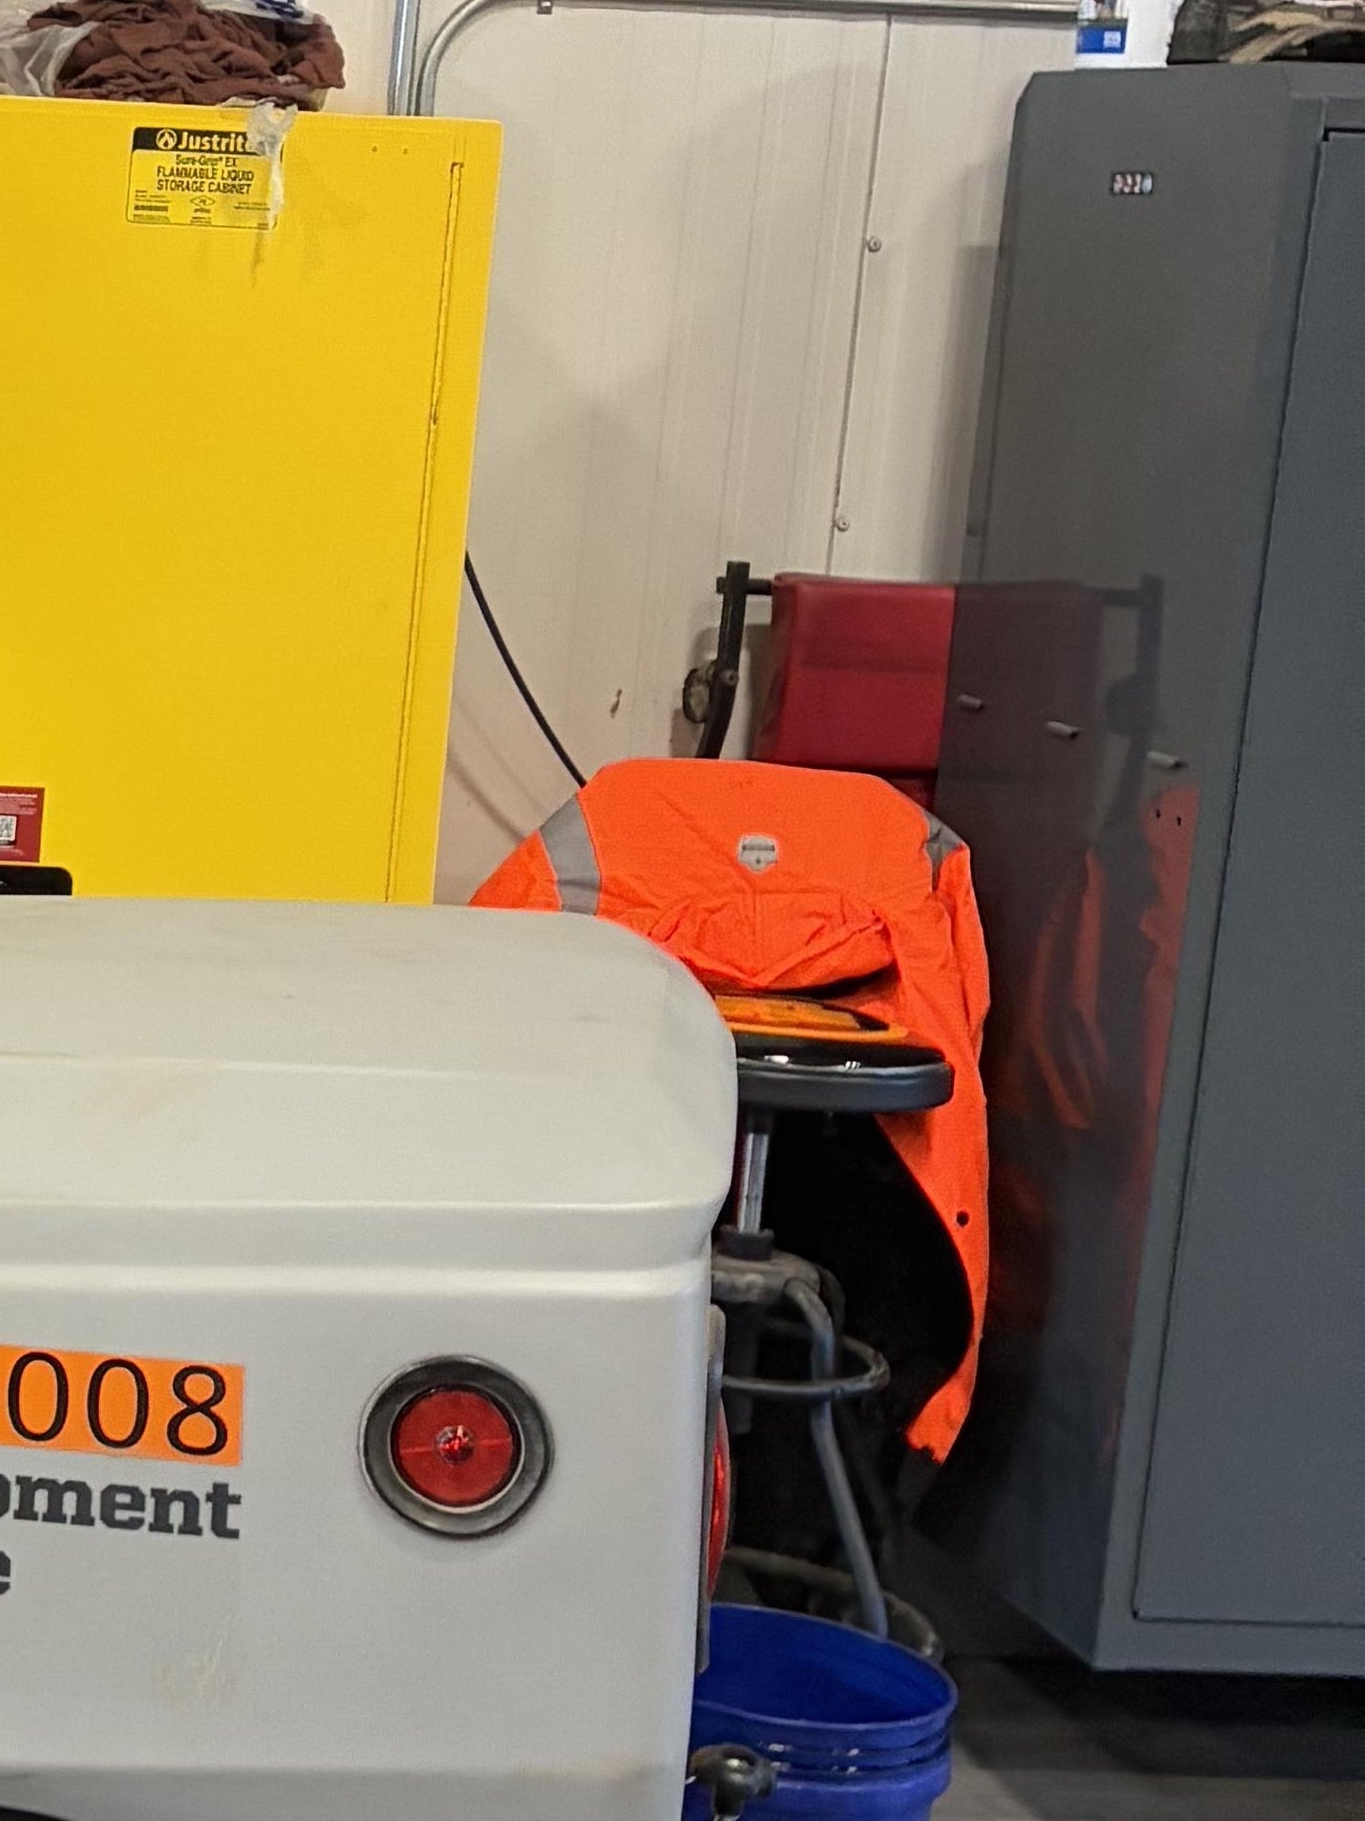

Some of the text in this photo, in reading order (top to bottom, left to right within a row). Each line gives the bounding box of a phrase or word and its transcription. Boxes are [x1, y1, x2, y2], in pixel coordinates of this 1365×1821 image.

[178, 132, 255, 153] Justrit
[157, 166, 254, 181] FLAMMABLE LIQUID
[157, 179, 252, 194] STORAGE CABINET
